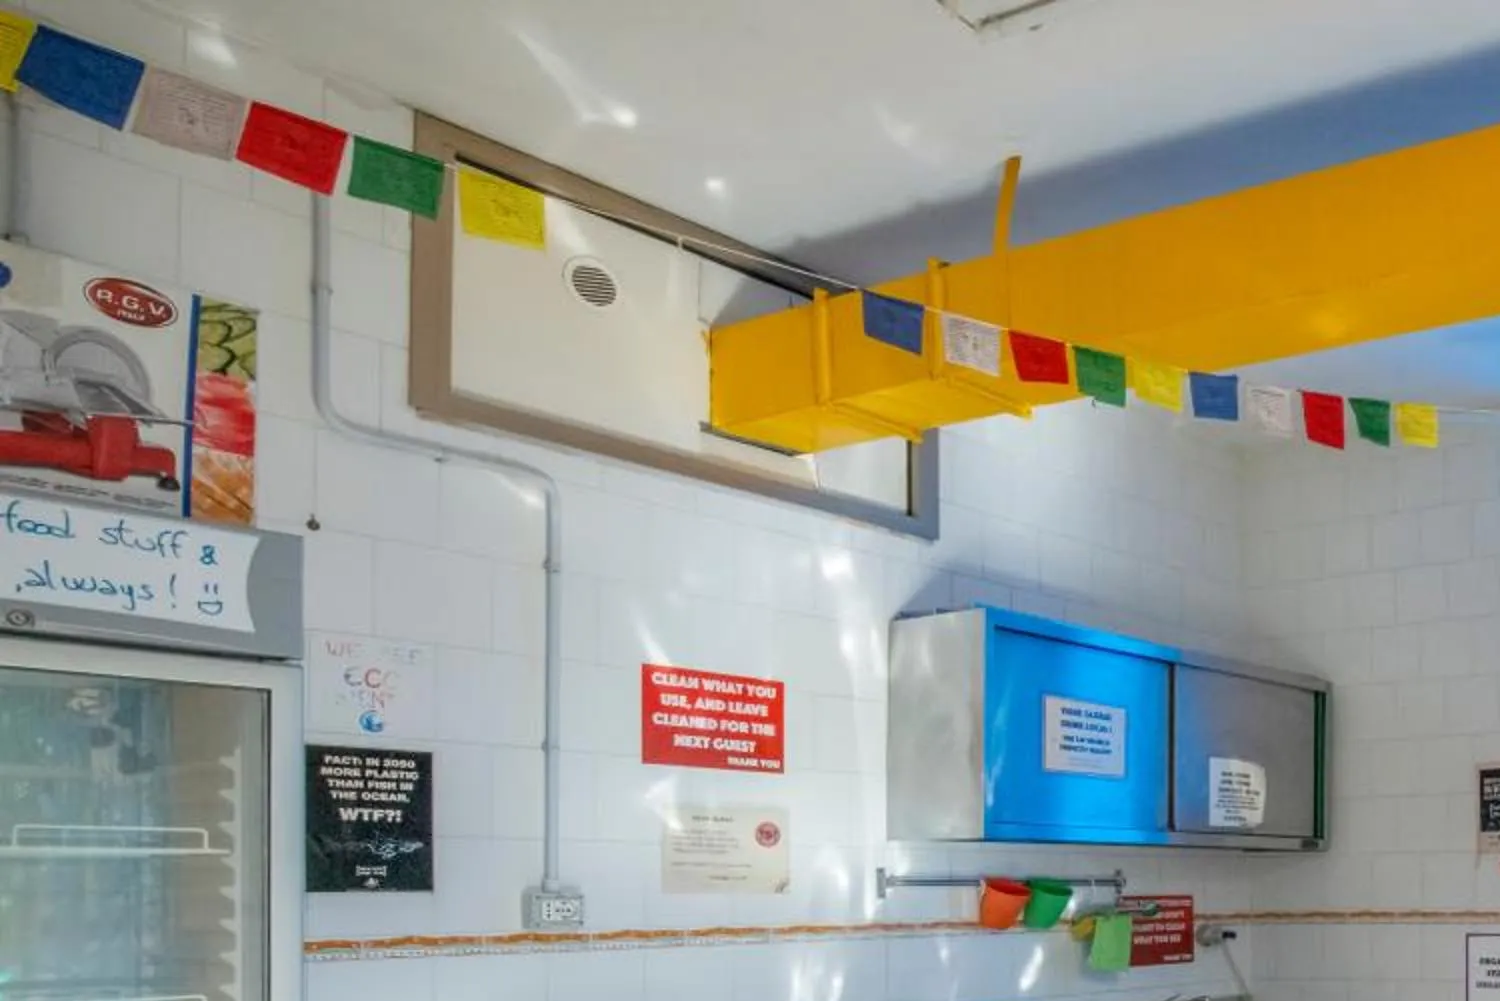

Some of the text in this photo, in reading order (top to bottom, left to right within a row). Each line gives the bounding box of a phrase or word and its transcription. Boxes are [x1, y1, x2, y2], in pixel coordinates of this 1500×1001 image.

[98, 519, 190, 559] stuff
[651, 671, 777, 699] CLEAN WHAT YOU
[693, 696, 726, 712] AND
[728, 701, 769, 717] LEAVE
[652, 711, 776, 737] CLEANED FOR THE
[672, 733, 711, 749] NEXT
[364, 757, 380, 767] IN
[320, 766, 419, 781] MORE PLASTIC
[327, 778, 364, 790] THAN
[366, 780, 397, 791] FISH
[330, 789, 358, 801] THE
[338, 806, 403, 823] WTF?!
